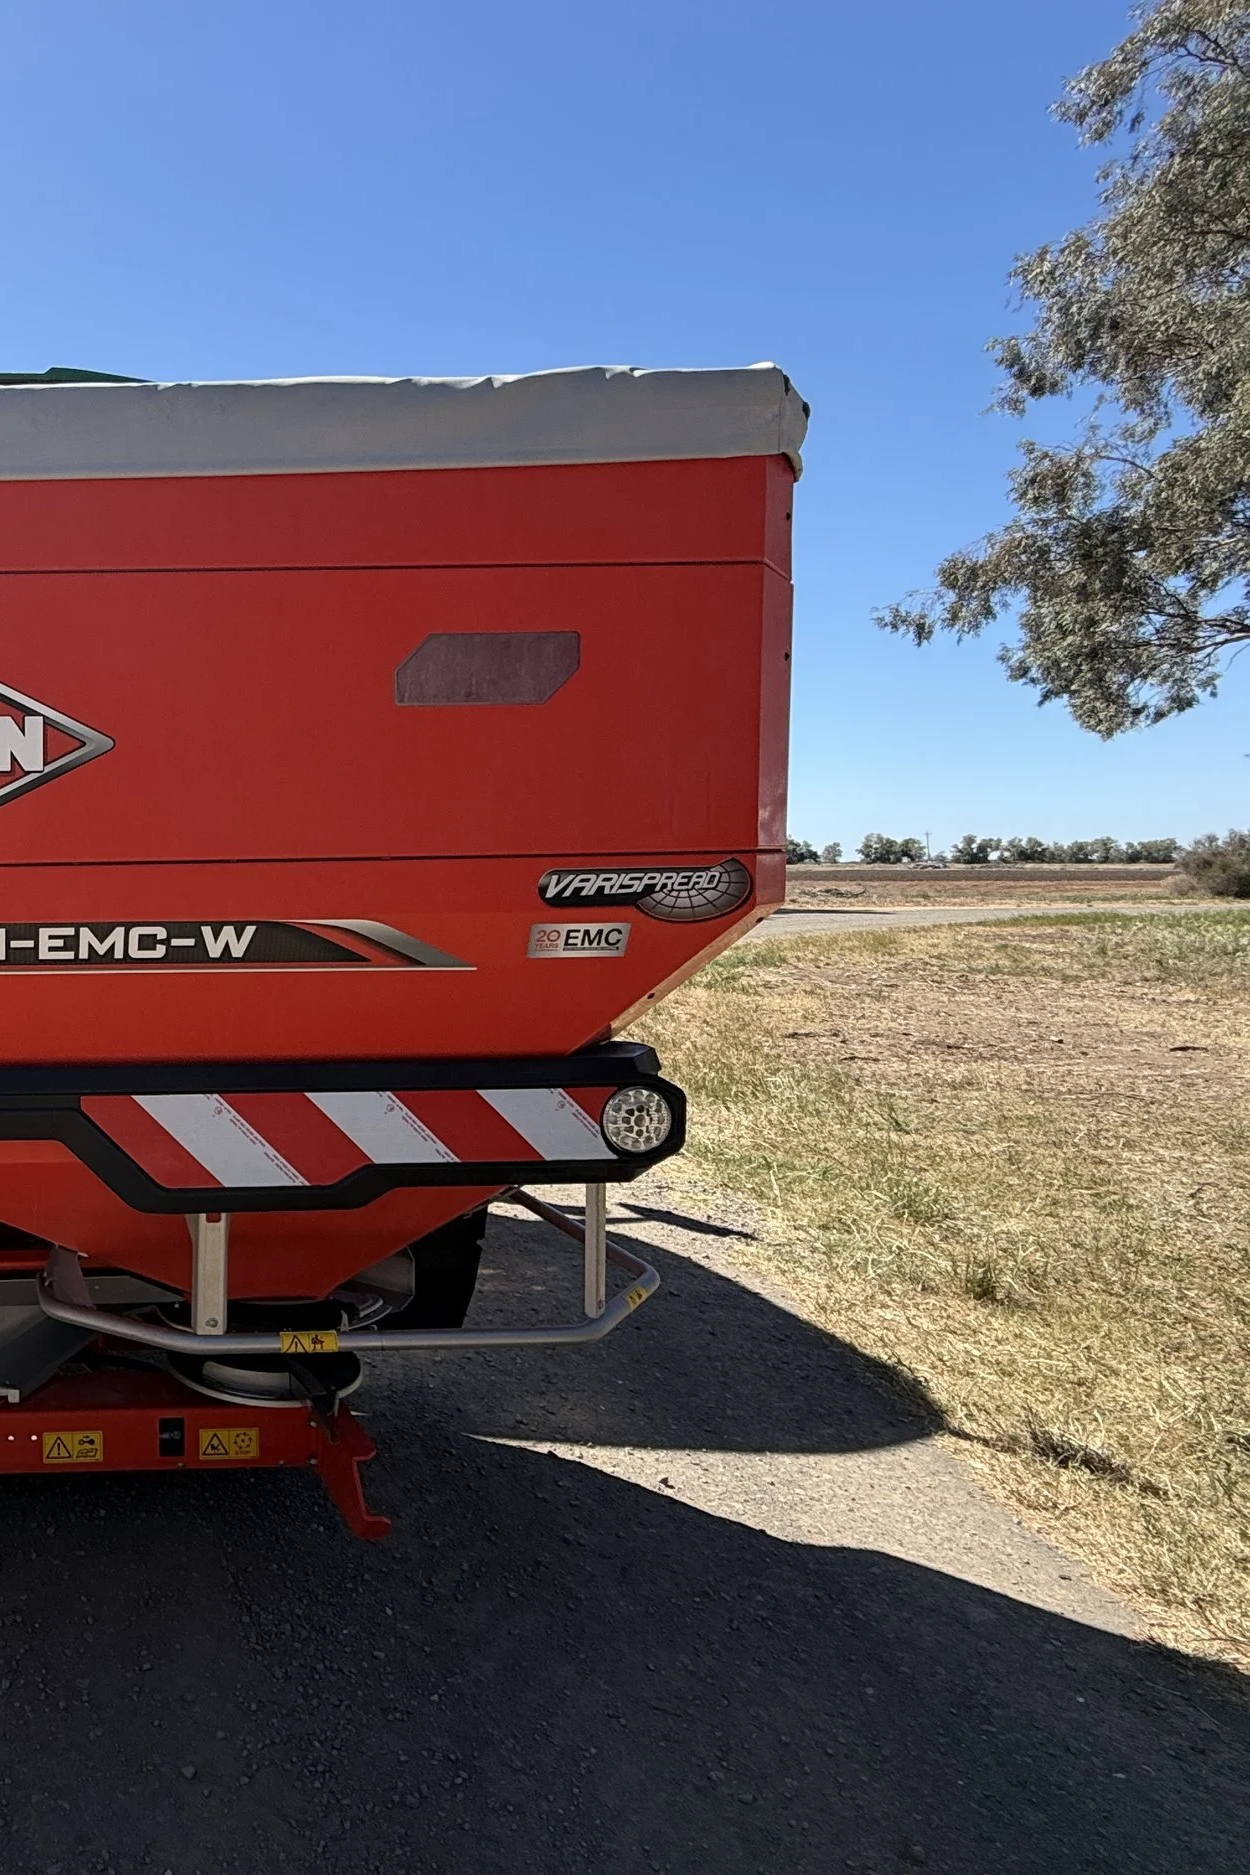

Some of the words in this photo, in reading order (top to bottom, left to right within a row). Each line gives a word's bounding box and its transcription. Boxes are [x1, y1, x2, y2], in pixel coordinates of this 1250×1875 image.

[545, 871, 720, 899] VARISPREAD
[537, 929, 561, 942] 20
[563, 928, 623, 947] EMC
